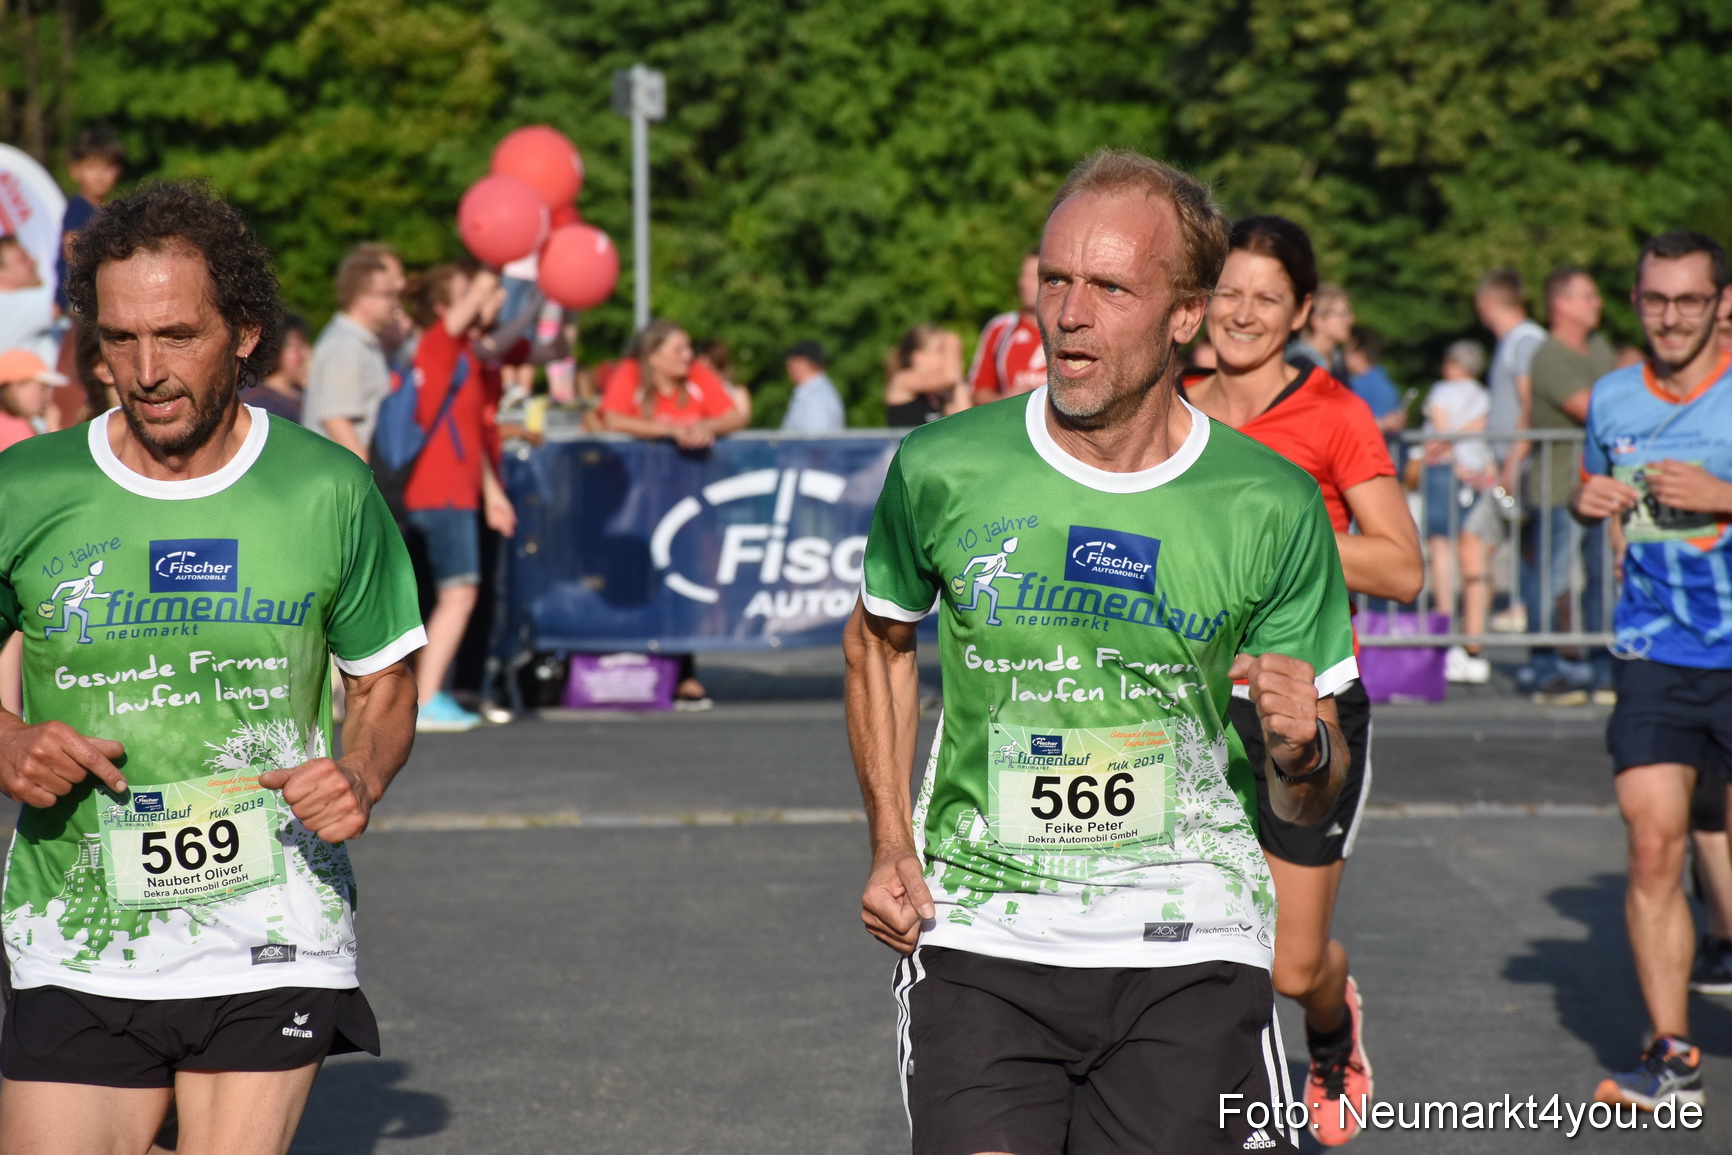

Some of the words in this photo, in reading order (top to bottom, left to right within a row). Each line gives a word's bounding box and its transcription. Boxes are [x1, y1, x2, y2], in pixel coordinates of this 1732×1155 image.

[957, 530, 977, 552] 10
[41, 556, 64, 579] 10
[170, 560, 232, 574] Fischer
[1086, 551, 1152, 574] Fischer
[175, 573, 227, 581] AUTOMOBILE
[1091, 565, 1146, 580] AUTOMOBILE
[105, 587, 316, 626] firmenlauf
[1017, 572, 1230, 642] firmenlauf
[1016, 614, 1110, 632] neumarkt
[106, 625, 199, 640] neumarkt
[964, 644, 1081, 673] Gesunde
[55, 654, 176, 690] Gesunde
[189, 650, 288, 674] Firmen
[1011, 677, 1104, 703] laufen
[109, 685, 200, 716] laufen
[1017, 751, 1091, 766] firmenlauf
[1134, 753, 1164, 768] 2019
[1030, 772, 1136, 820] 566
[124, 805, 192, 822] firmenlauf
[234, 797, 264, 814] 2019
[1045, 822, 1083, 834] Feike
[1088, 820, 1124, 833] Peter
[1028, 835, 1056, 844] Dekra
[1059, 834, 1108, 844] Automobil
[1110, 829, 1138, 841] GmbH
[141, 819, 240, 874] 569
[147, 873, 201, 888] Naubert
[204, 863, 243, 881] Oliver
[143, 886, 170, 898] Dekra
[172, 882, 220, 896] Automobil
[222, 873, 249, 887] GmbH
[1151, 926, 1178, 935] AOK
[1195, 926, 1240, 934] Frischmann
[258, 946, 284, 958] AOK
[282, 1027, 313, 1038] erima
[1243, 1139, 1276, 1150] adidas
